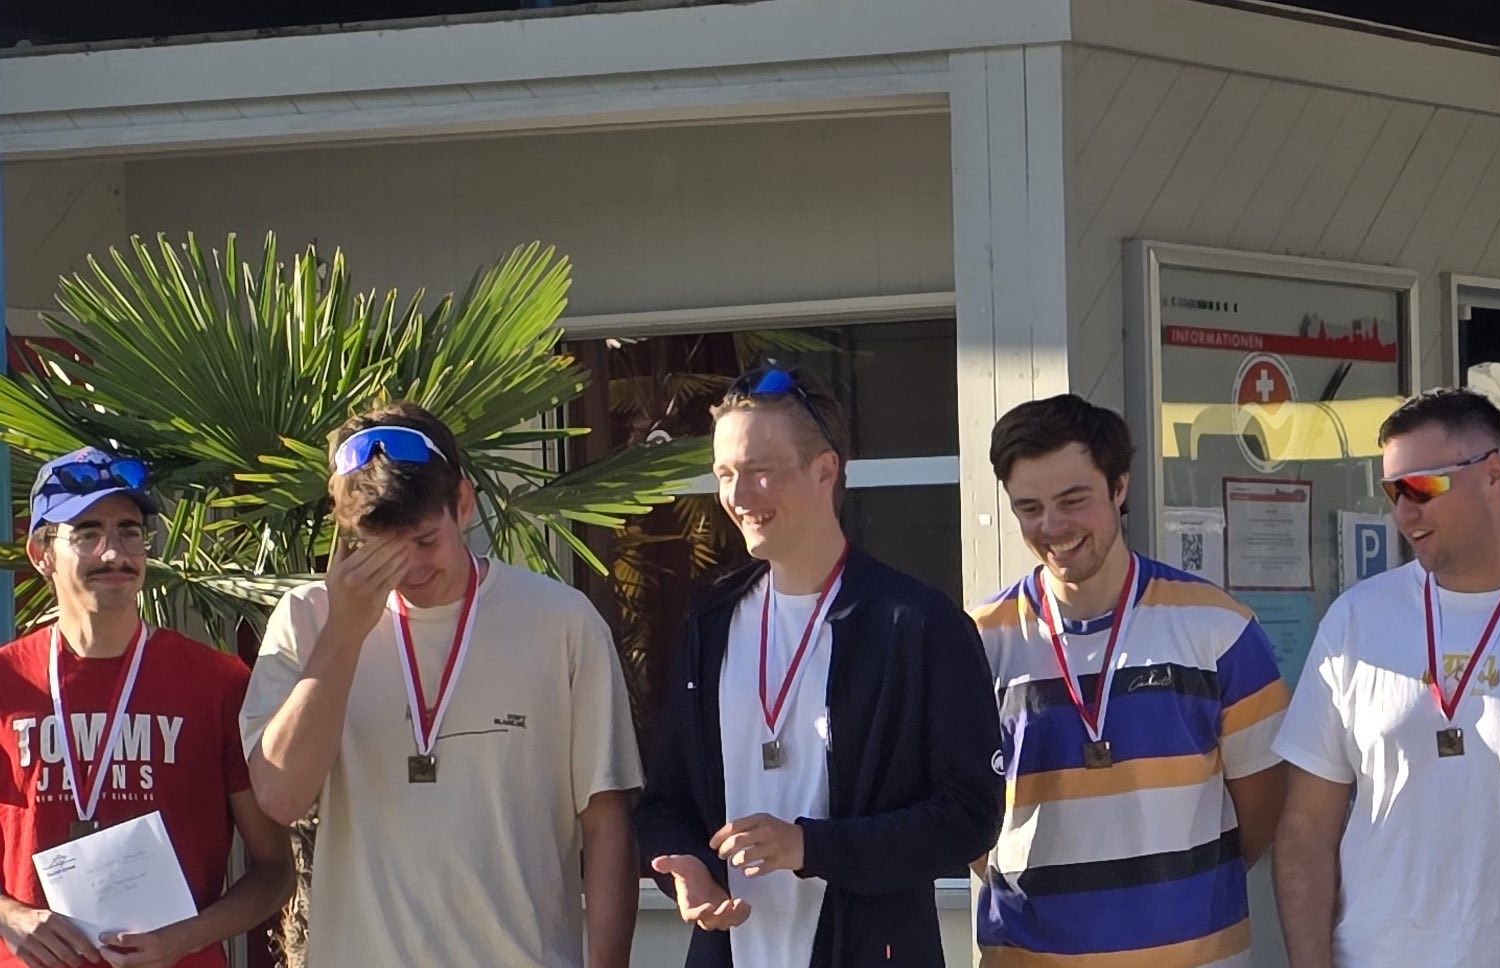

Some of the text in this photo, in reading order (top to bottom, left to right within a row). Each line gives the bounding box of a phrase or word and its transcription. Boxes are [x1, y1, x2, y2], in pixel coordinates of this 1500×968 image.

[1171, 328, 1264, 348] INFORMATIONEN
[1361, 529, 1380, 576] P
[12, 713, 184, 768] TOMMY
